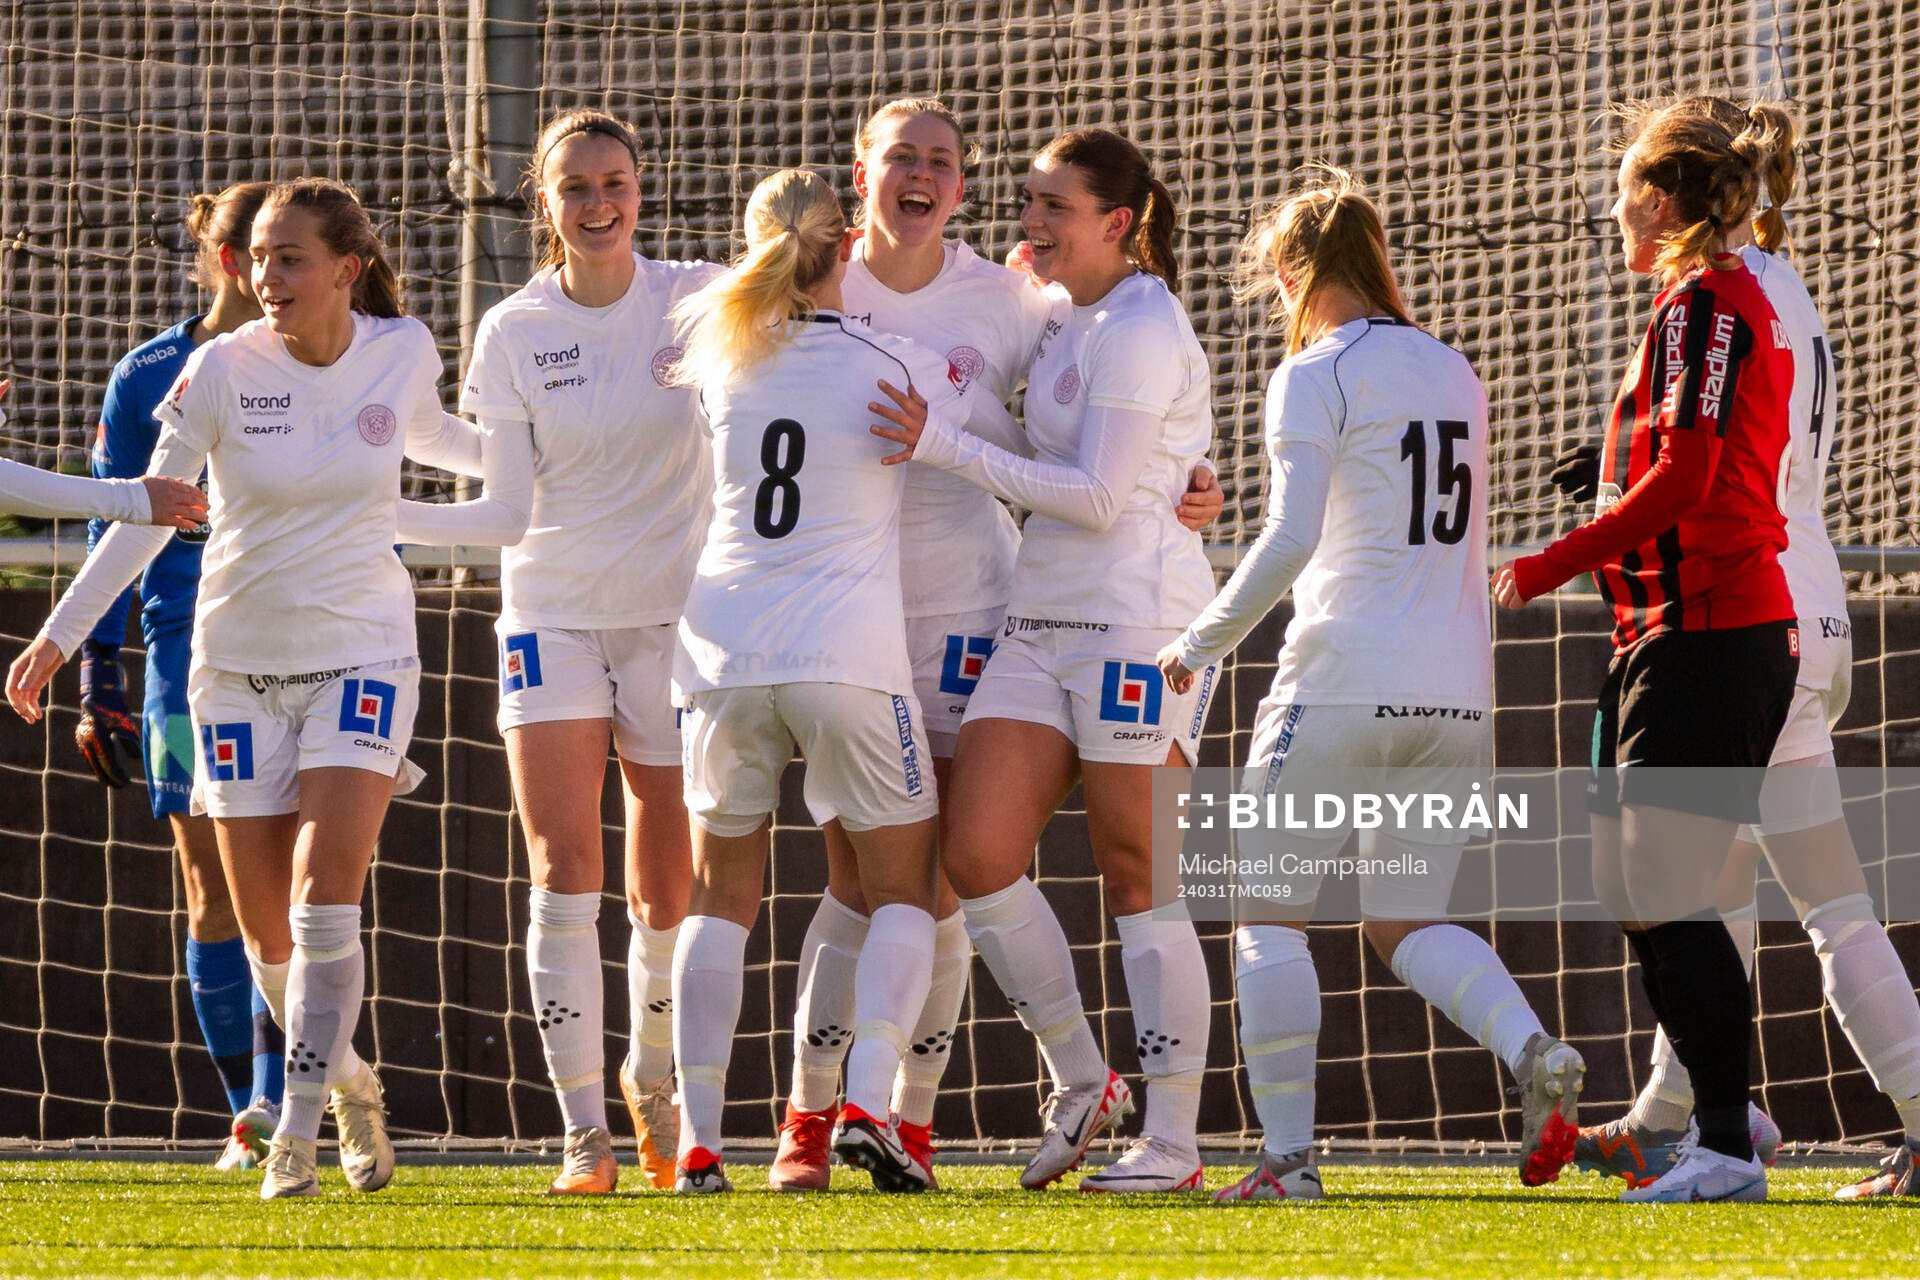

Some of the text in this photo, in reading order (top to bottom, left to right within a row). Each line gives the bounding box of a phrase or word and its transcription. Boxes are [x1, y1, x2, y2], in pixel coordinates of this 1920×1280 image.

[134, 345, 178, 368] Heba
[533, 343, 580, 367] brand
[1662, 304, 1688, 413] stadium
[1700, 312, 1735, 420] stadium
[544, 377, 577, 391] CRAFT
[239, 392, 291, 409] brand
[243, 425, 283, 434] CRAFT
[753, 418, 806, 540] 8
[1401, 420, 1472, 546] 15
[353, 738, 390, 754] CRAFT
[1113, 731, 1154, 741] CRAFT
